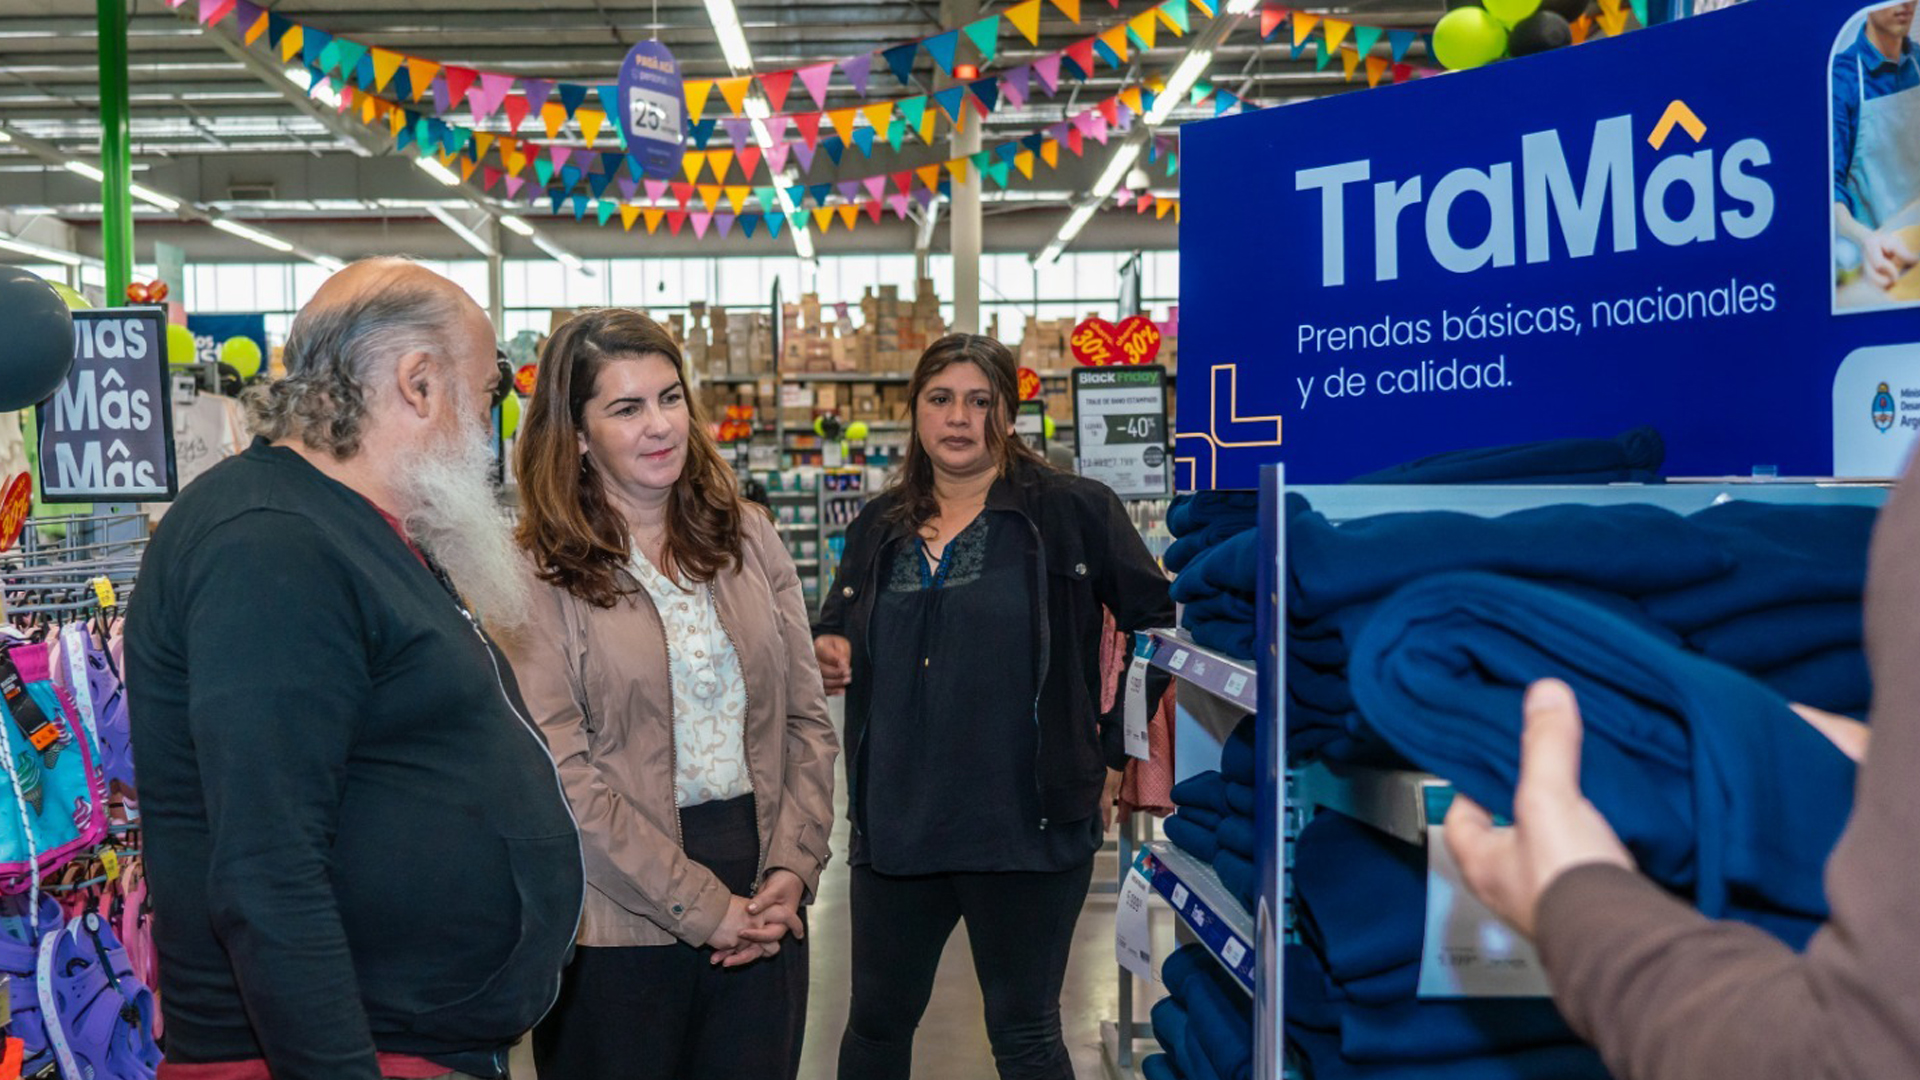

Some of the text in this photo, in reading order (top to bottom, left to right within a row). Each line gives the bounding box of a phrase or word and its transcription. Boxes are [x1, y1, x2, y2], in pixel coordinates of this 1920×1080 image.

[1298, 278, 1776, 353] Prendas básicas, nacionales
[1071, 330, 1111, 366] 30%
[1124, 325, 1159, 365] 30%
[1080, 370, 1158, 384] Black Friday
[1296, 355, 1512, 409] y de calidad.
